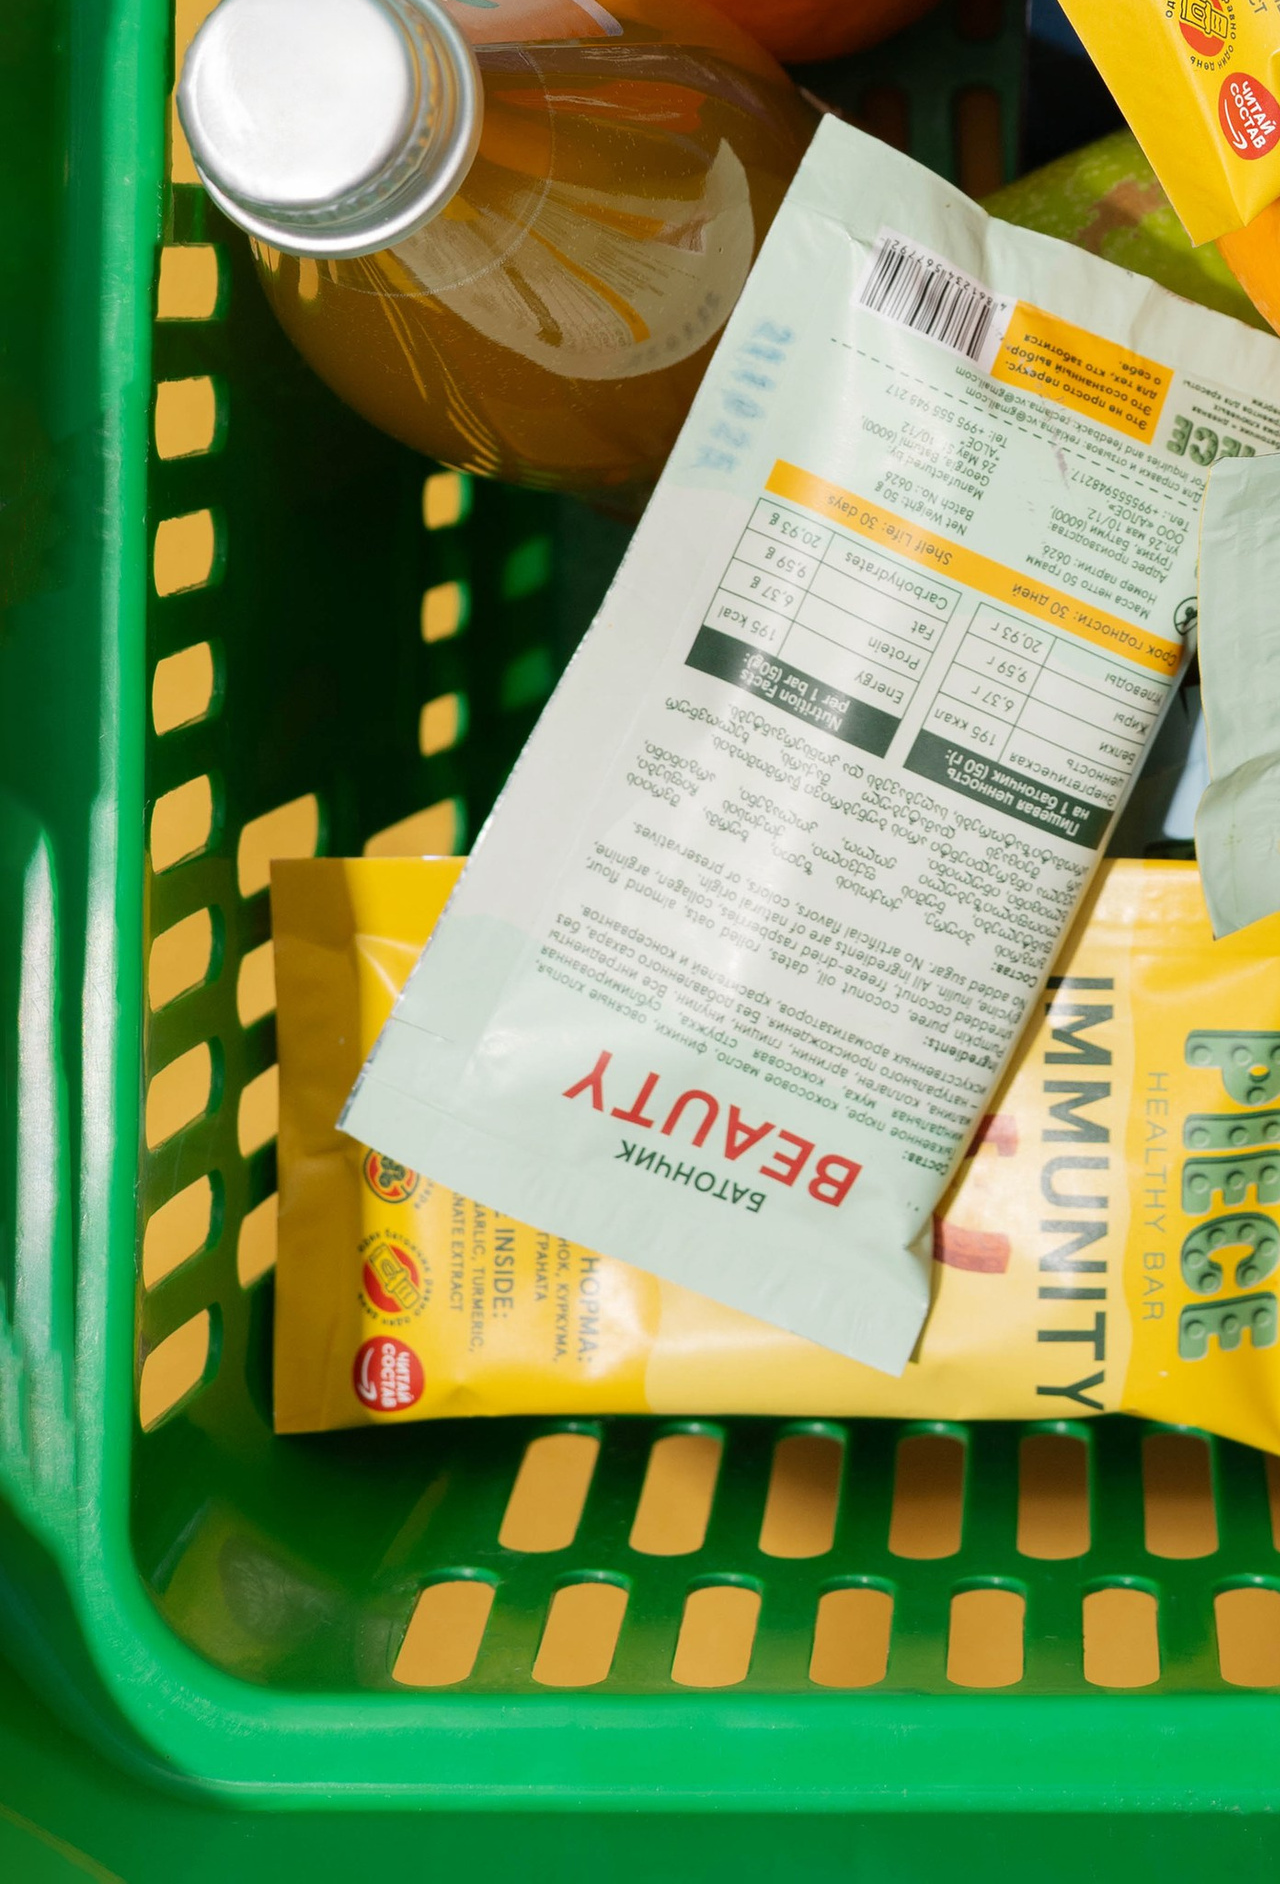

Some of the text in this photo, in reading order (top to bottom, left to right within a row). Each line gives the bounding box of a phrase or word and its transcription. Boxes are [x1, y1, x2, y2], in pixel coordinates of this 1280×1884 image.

[1230, 83, 1266, 148] СОСТАВ
[1242, 81, 1276, 135] ЧИТАЙ
[884, 471, 975, 522] Batch No.: 0626
[901, 496, 968, 536] Net Weight:
[780, 521, 822, 549] 20,93
[828, 495, 953, 565] Shelf Life: 30 days
[776, 556, 806, 579] 9,59
[845, 552, 948, 610] Carbohydrates
[761, 586, 794, 607] 6,37
[1012, 584, 1050, 606] дней
[1050, 602, 1070, 619] 30
[717, 606, 776, 641] 195 kcal
[911, 620, 935, 641] Fat
[1001, 626, 1043, 654] 20,93
[1073, 611, 1144, 650] годности:
[868, 637, 920, 671] Protein
[997, 661, 1027, 683] 9,59
[740, 669, 843, 731] Nutrition Facts
[782, 674, 809, 697] bar
[821, 695, 851, 713] per
[854, 671, 904, 705] Energy
[981, 691, 1015, 712] 6,37
[934, 708, 996, 746] 195 ккал
[1099, 742, 1136, 766] Белки
[964, 759, 1058, 810] батончик (50
[1009, 752, 1117, 807] Энергетическая
[947, 768, 1080, 836] Пищевая ценность
[594, 841, 650, 876] arginine,
[655, 870, 713, 909] collagen,
[586, 856, 950, 1034] puree, coconut oil, dates, rolled oats, almond flour,
[718, 903, 798, 950] raspberries,
[799, 945, 888, 993] freeze-dried
[894, 983, 953, 1017] coconut,
[564, 1052, 862, 1207] BEAUTY
[615, 1140, 766, 1213] БАТОНЧИК
[1034, 976, 1117, 1412] IMMUNITY
[1142, 1072, 1169, 1320] HEALTHY BAR
[449, 1241, 464, 1311] EXTRACT
[493, 1229, 515, 1318] INSIDE:
[468, 1268, 486, 1353] TURMERIC,
[380, 1343, 396, 1408] СОСТАВ
[397, 1351, 414, 1404] ЧИТАЙ
